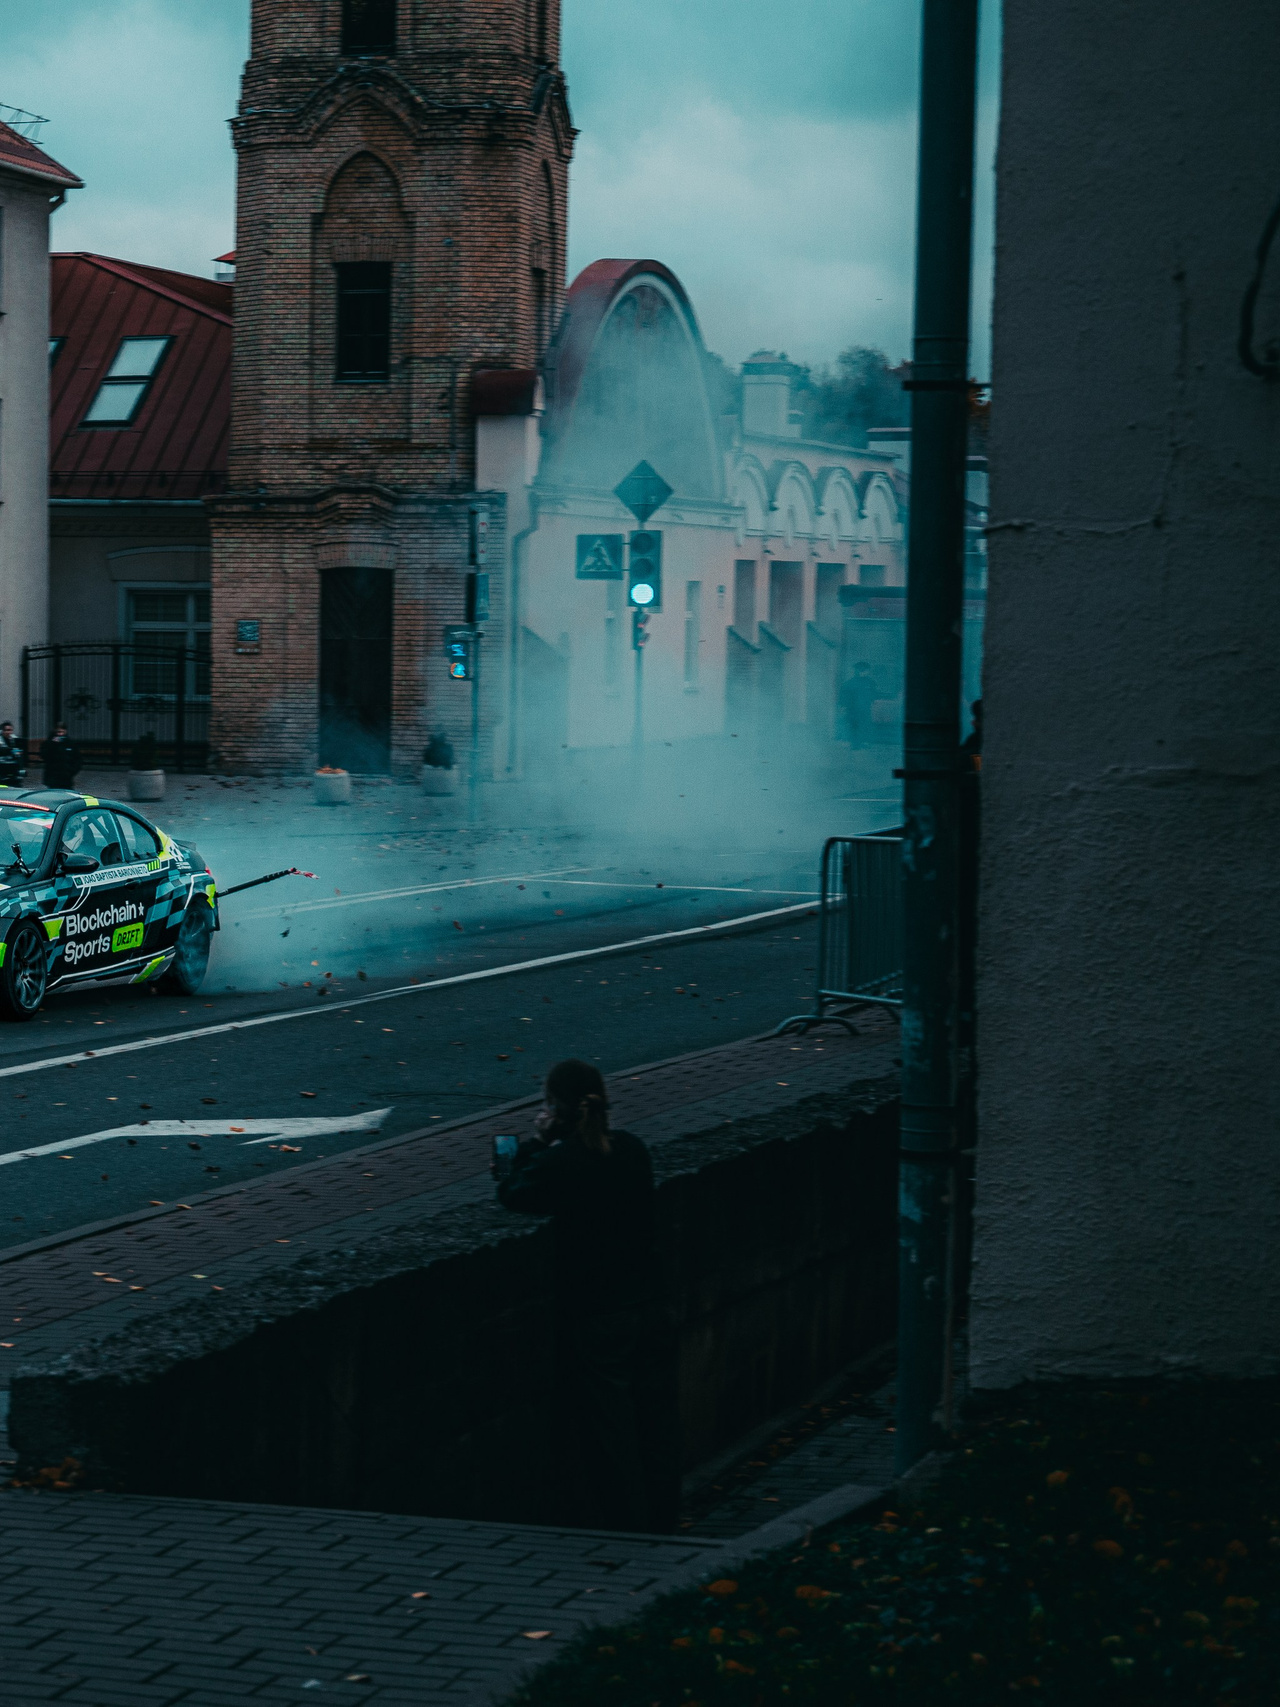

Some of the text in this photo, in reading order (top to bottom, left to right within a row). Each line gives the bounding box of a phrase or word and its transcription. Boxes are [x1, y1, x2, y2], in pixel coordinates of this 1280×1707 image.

[66, 900, 137, 936] Blockchain
[64, 929, 141, 965] Sports DRIFT
